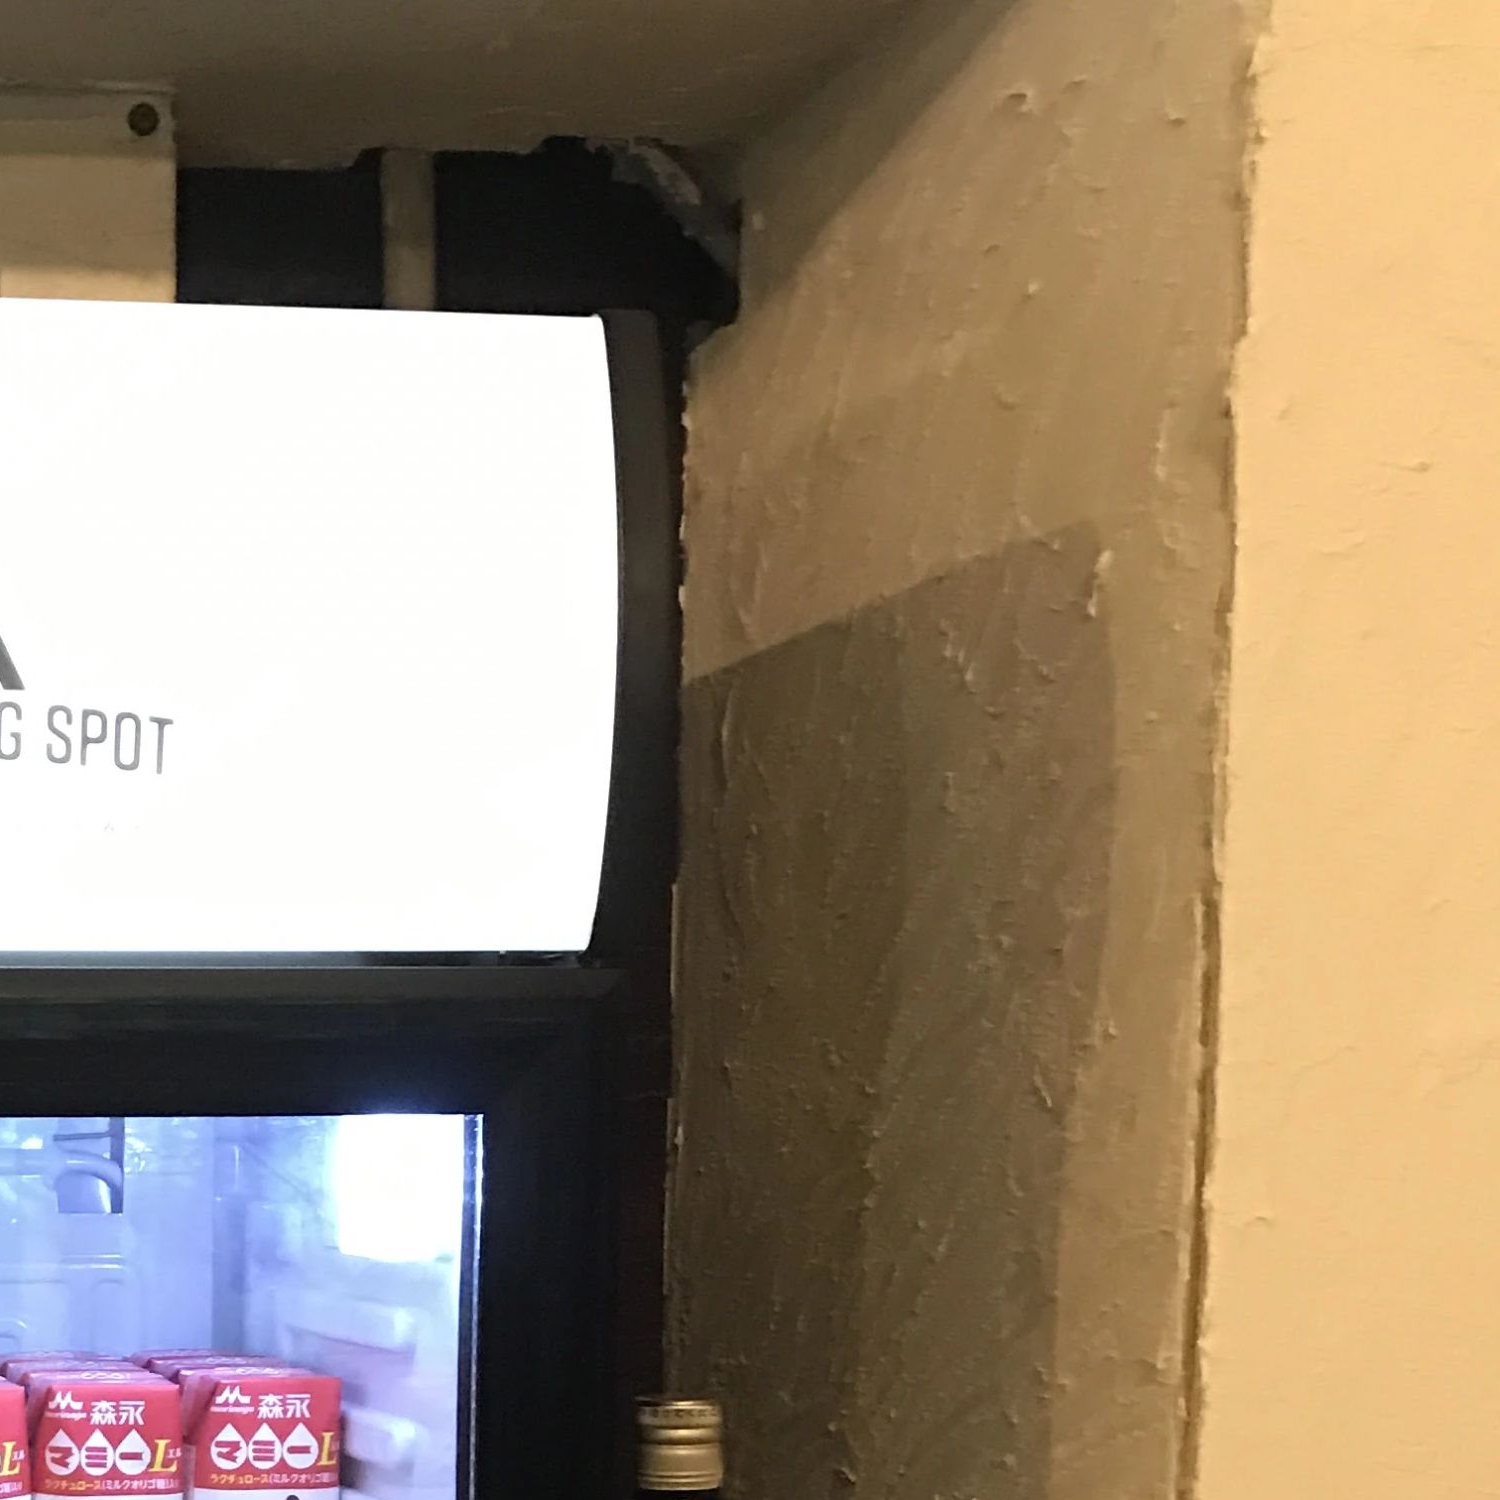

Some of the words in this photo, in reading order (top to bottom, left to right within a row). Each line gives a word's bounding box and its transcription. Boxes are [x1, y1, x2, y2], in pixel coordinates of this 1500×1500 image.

[46, 704, 174, 775] SPOT
[90, 1400, 146, 1426] 森永
[257, 1393, 311, 1419] 森永
[46, 1443, 146, 1472] マミー
[148, 1439, 178, 1473] L
[212, 1437, 313, 1466] マミー
